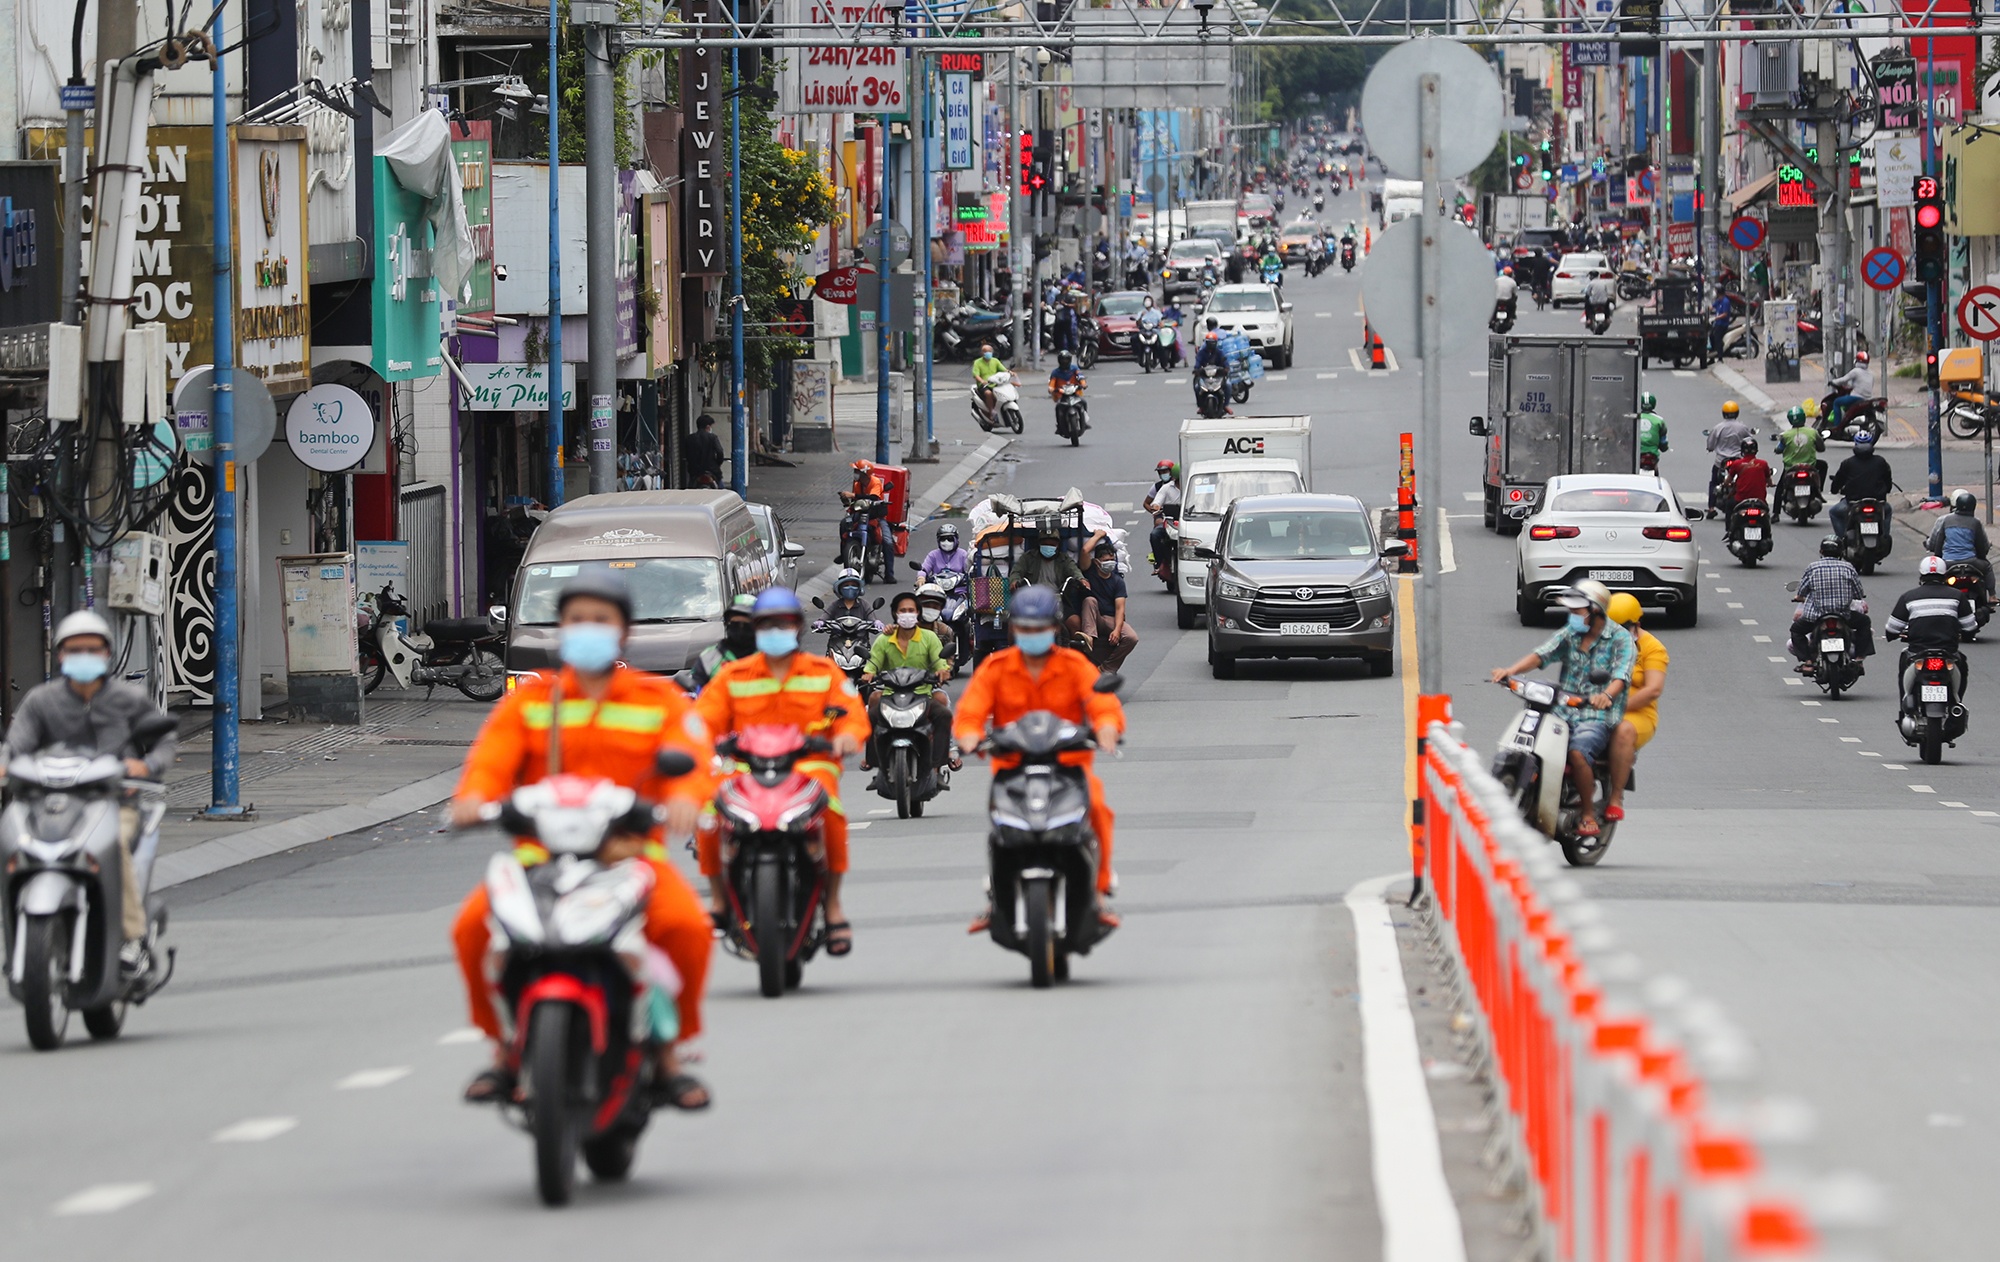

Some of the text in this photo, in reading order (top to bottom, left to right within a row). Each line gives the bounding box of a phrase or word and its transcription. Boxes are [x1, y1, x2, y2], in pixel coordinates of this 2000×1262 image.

[808, 46, 897, 70] 24h/24h
[805, 75, 901, 106] LÃI SUẤT 3%
[1879, 78, 1912, 105] NỐI
[1918, 180, 1937, 199] 23
[506, 383, 572, 409] Phụg
[1526, 392, 1546, 402] 51D
[1519, 402, 1552, 413] 467.33
[300, 430, 360, 444] bamboo
[1223, 437, 1264, 454] ACE
[1282, 624, 1328, 635] 51G-624.65
